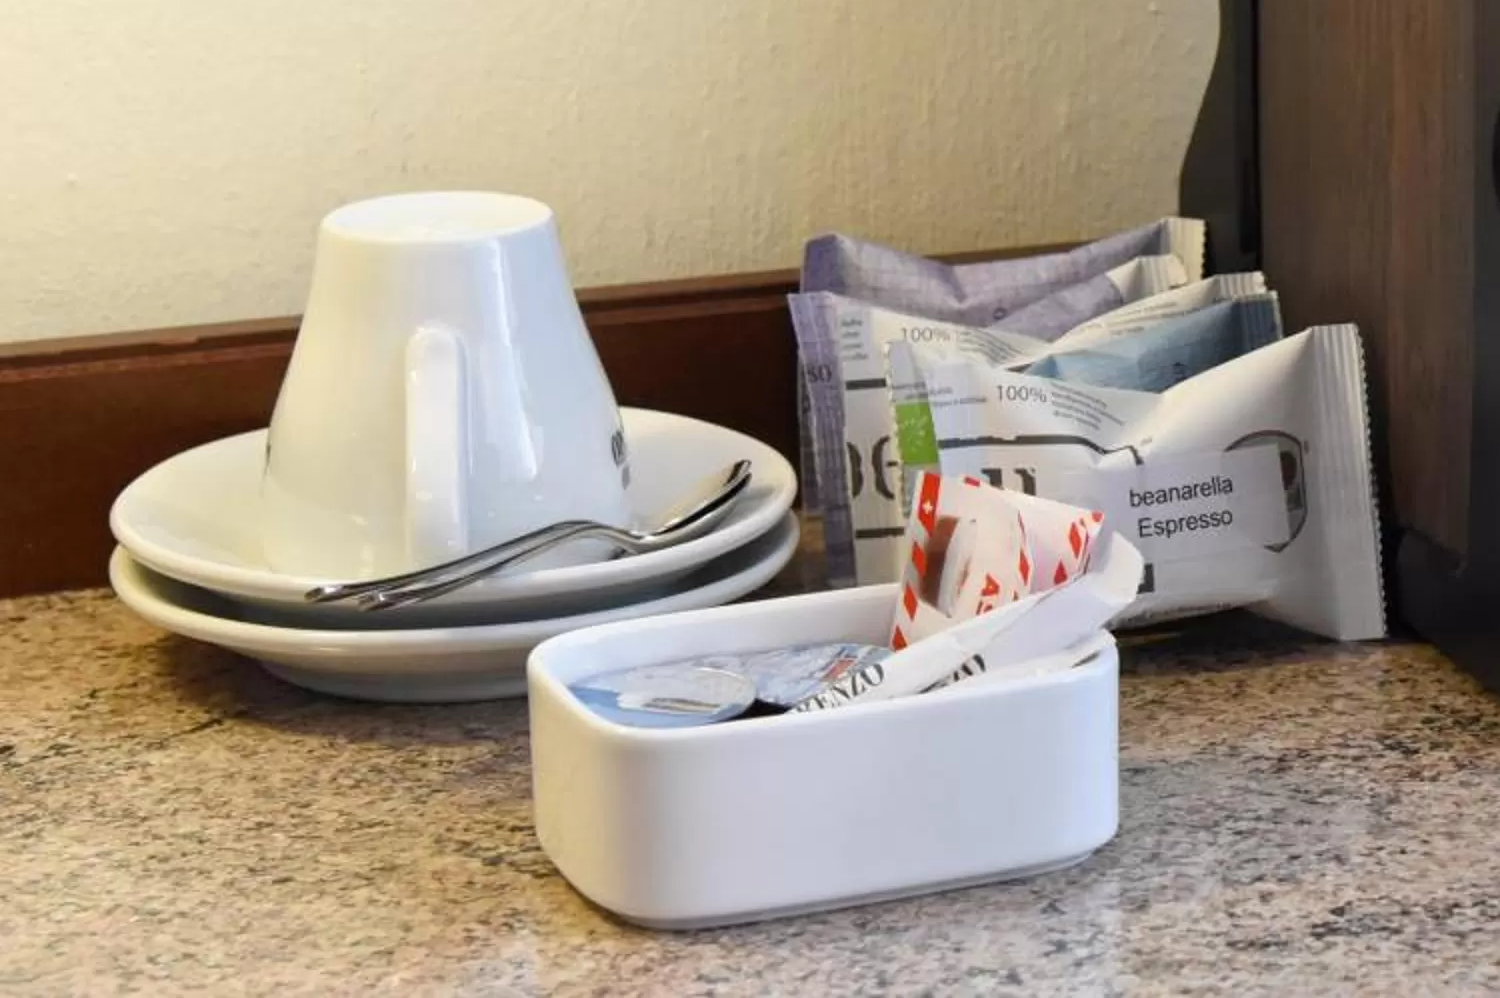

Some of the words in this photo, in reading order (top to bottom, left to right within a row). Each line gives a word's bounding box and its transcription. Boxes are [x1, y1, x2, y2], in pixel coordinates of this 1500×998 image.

[901, 325, 951, 344] 100%
[996, 384, 1048, 404] 100%
[1129, 475, 1234, 508] beanarella
[1137, 509, 1233, 540] Espresso
